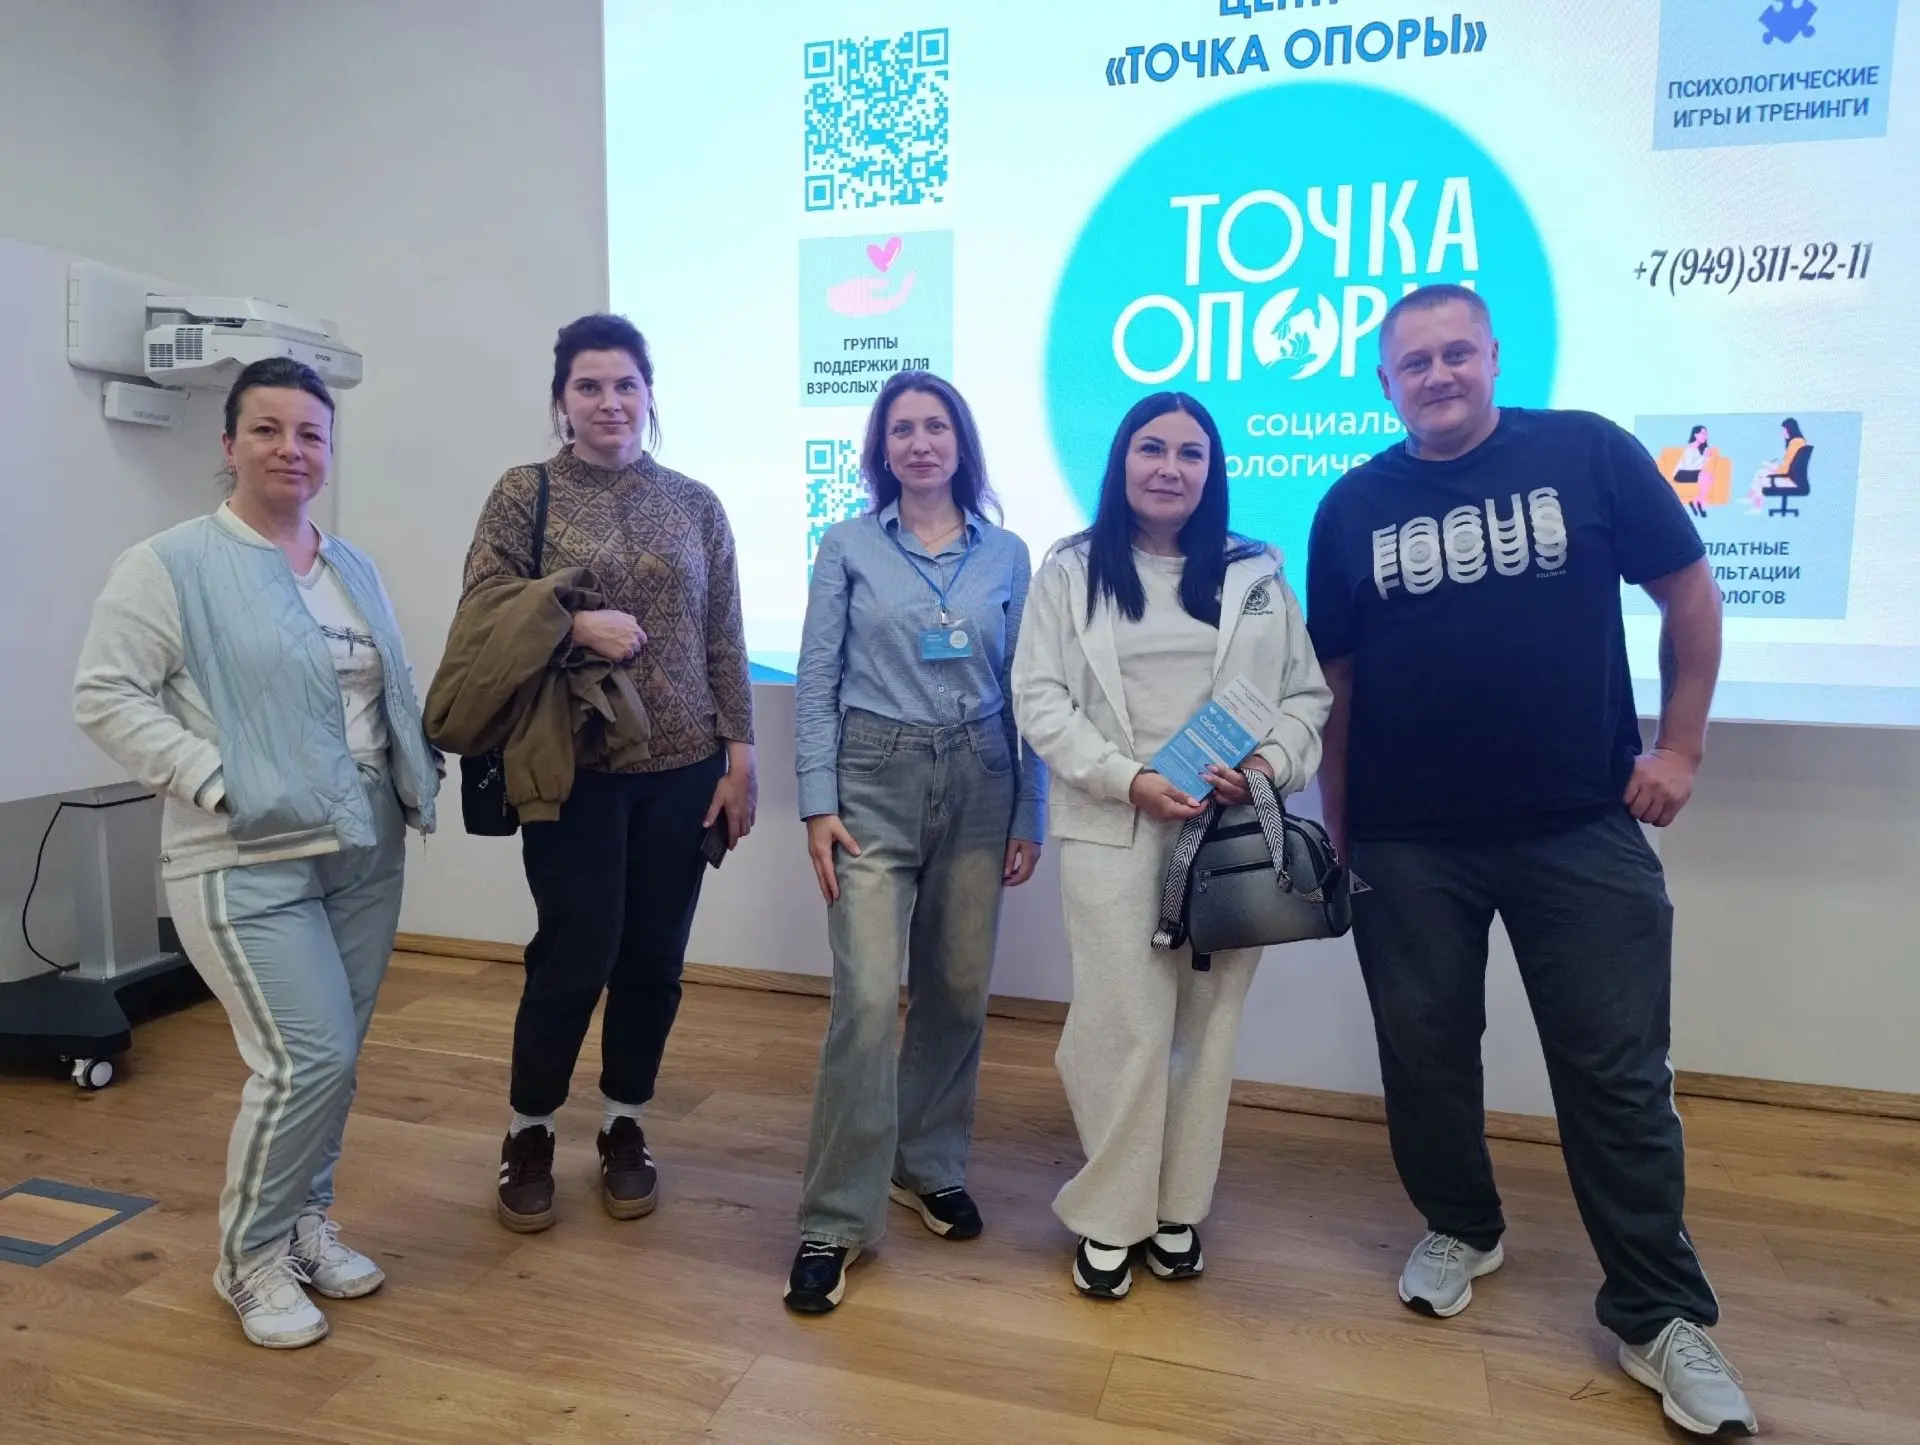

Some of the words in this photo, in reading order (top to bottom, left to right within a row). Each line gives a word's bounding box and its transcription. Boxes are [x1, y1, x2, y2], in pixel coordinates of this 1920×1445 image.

[1105, 35, 1270, 86] «ТОЧКА
[1284, 14, 1487, 69] ОПОРЫ»
[1668, 66, 1879, 99] ПСИХОЛОГИЧЕСКИЕ
[1673, 107, 1731, 128] ИГРЫ
[1736, 106, 1751, 124] И
[1757, 97, 1870, 123] ТРЕНИНГИ
[1170, 176, 1480, 286] ТОЧКА
[843, 337, 899, 351] ГРУППЫ
[1112, 280, 1475, 384] ОПОР
[813, 359, 898, 375] ПОДДЕРЖКИ
[901, 358, 930, 372] ДЛЯ
[807, 381, 878, 395] ВЗРОСЛЫХ
[1247, 411, 1407, 440] социаль
[1224, 452, 1373, 478] ологиче
[1372, 486, 1568, 601] FOCUS
[1703, 541, 1790, 556] ПЛАТНЫЕ
[1711, 566, 1801, 582] ЛЬТАЦИИ
